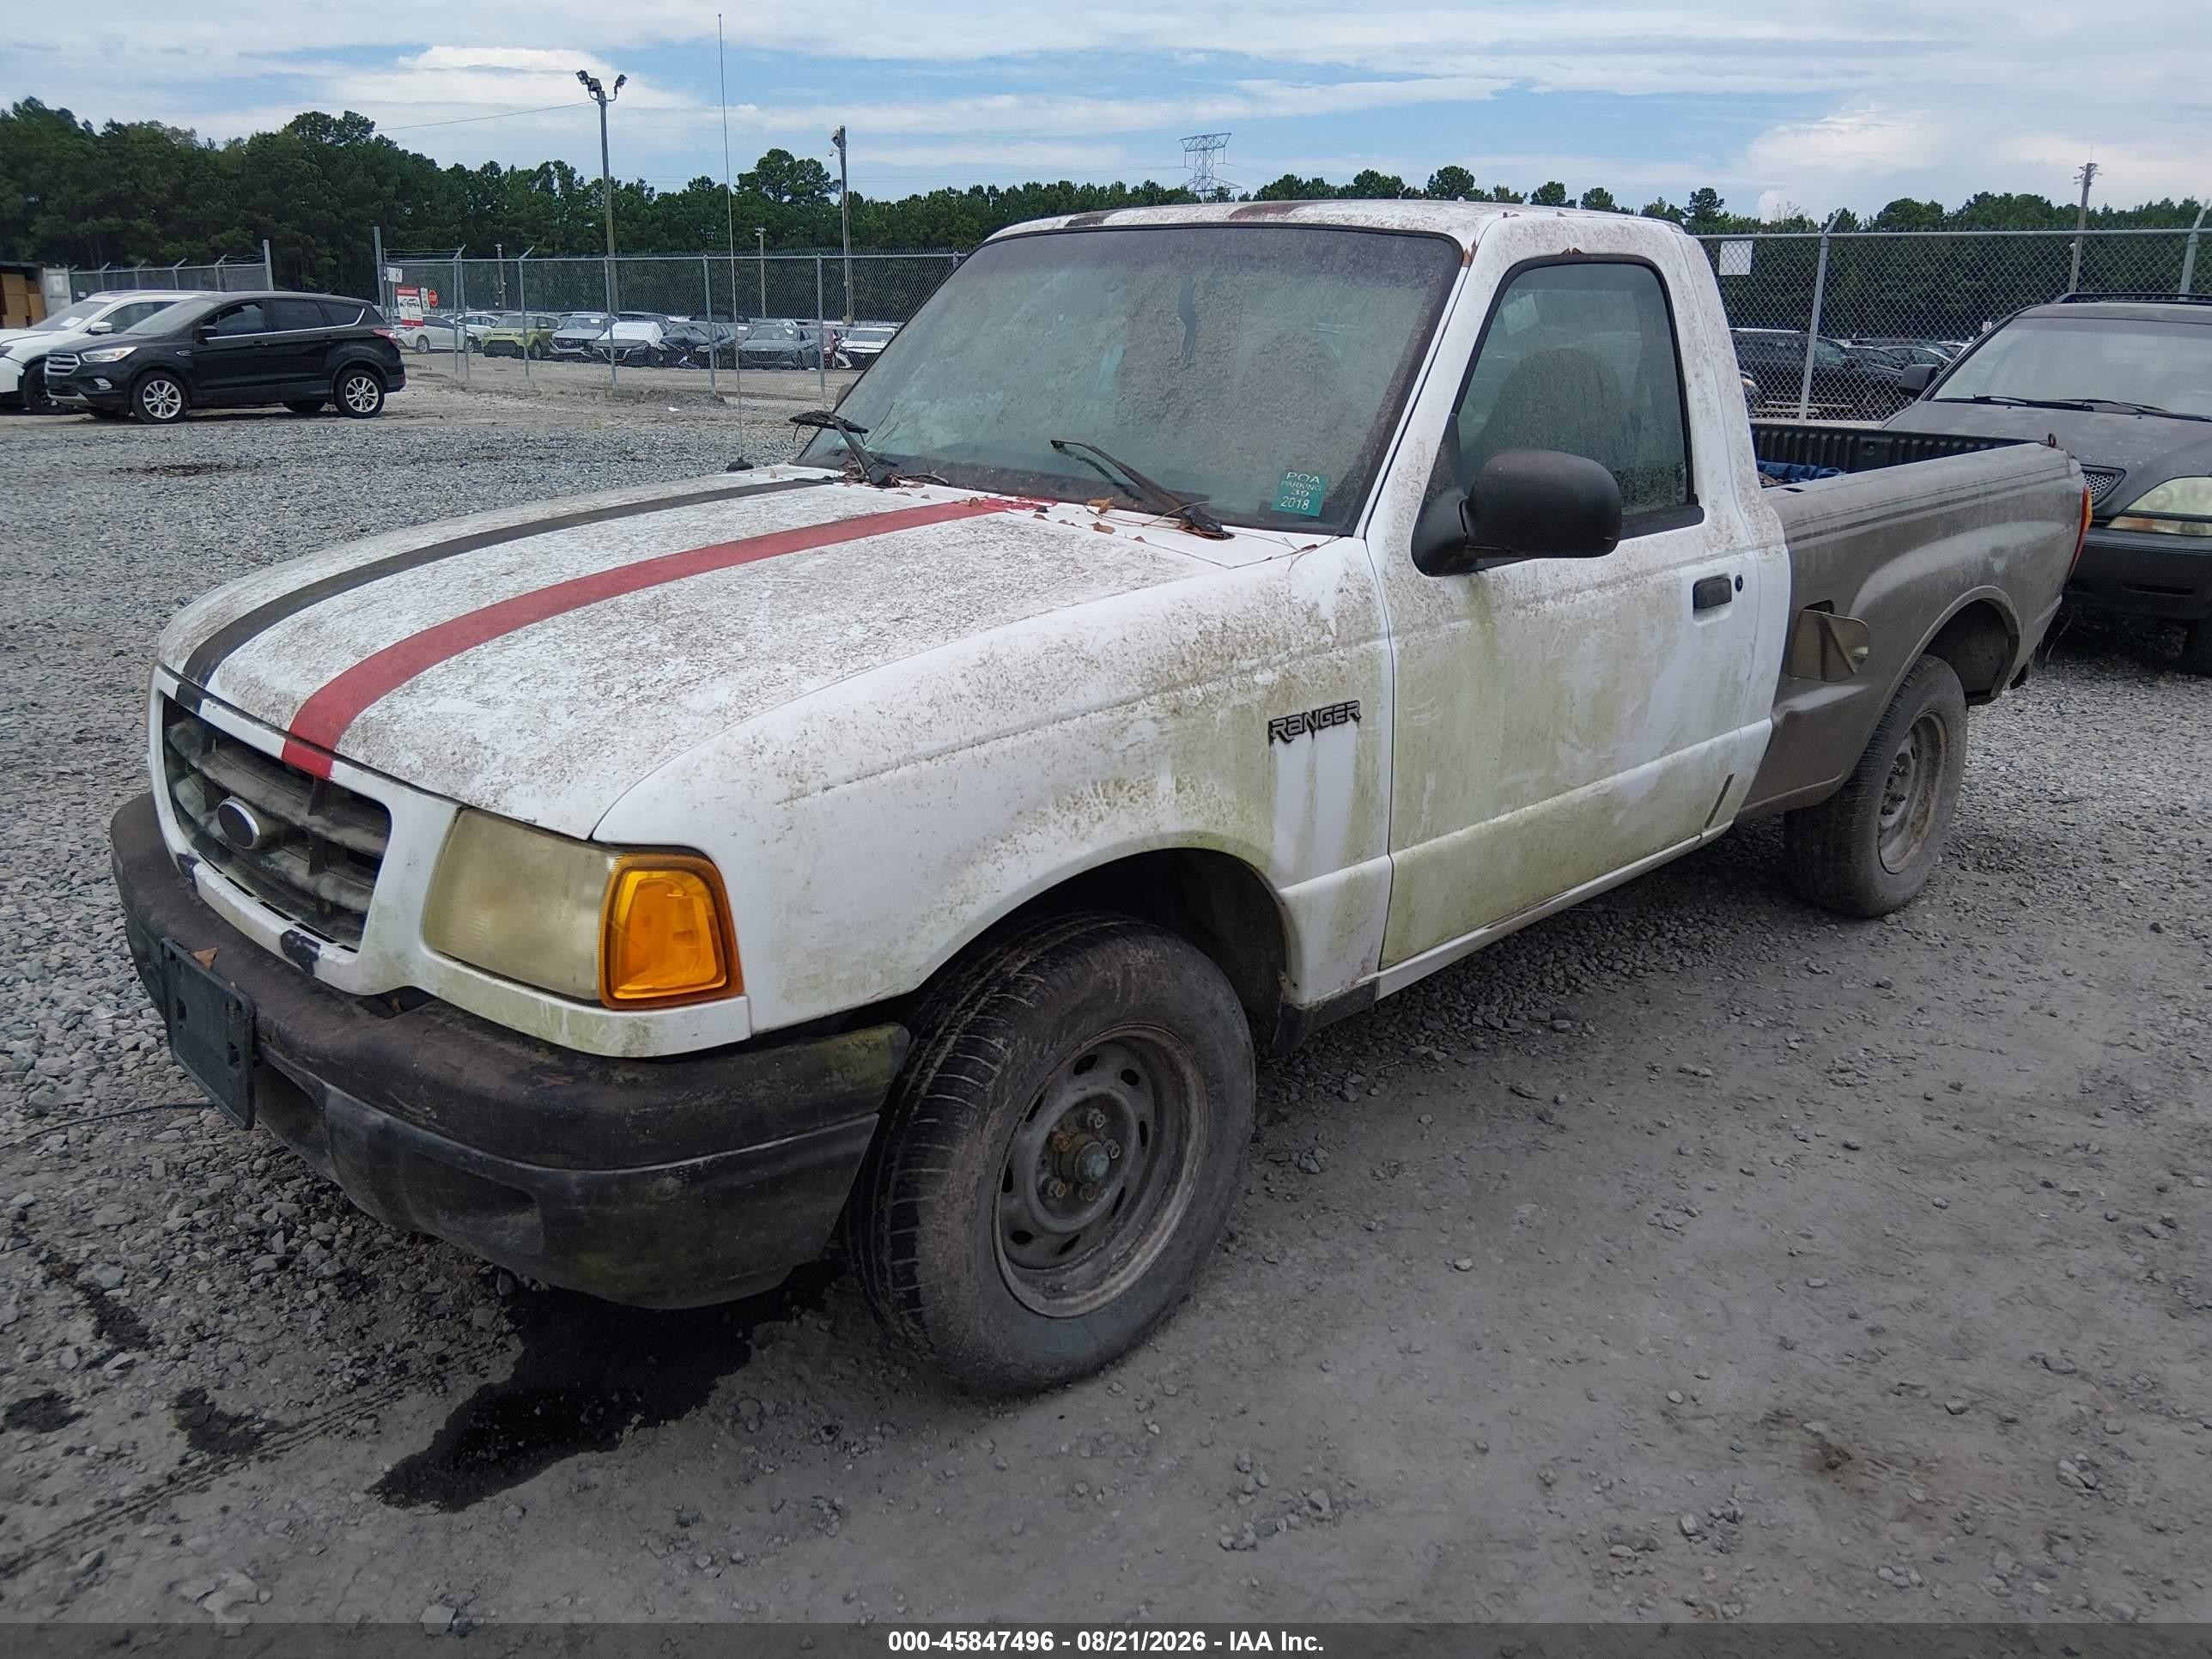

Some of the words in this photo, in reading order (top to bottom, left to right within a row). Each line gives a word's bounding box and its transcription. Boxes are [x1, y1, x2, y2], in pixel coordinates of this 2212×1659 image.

[1286, 471, 1320, 484] POA
[1280, 495, 1310, 511] 2018
[1268, 700, 1361, 744] RANGER
